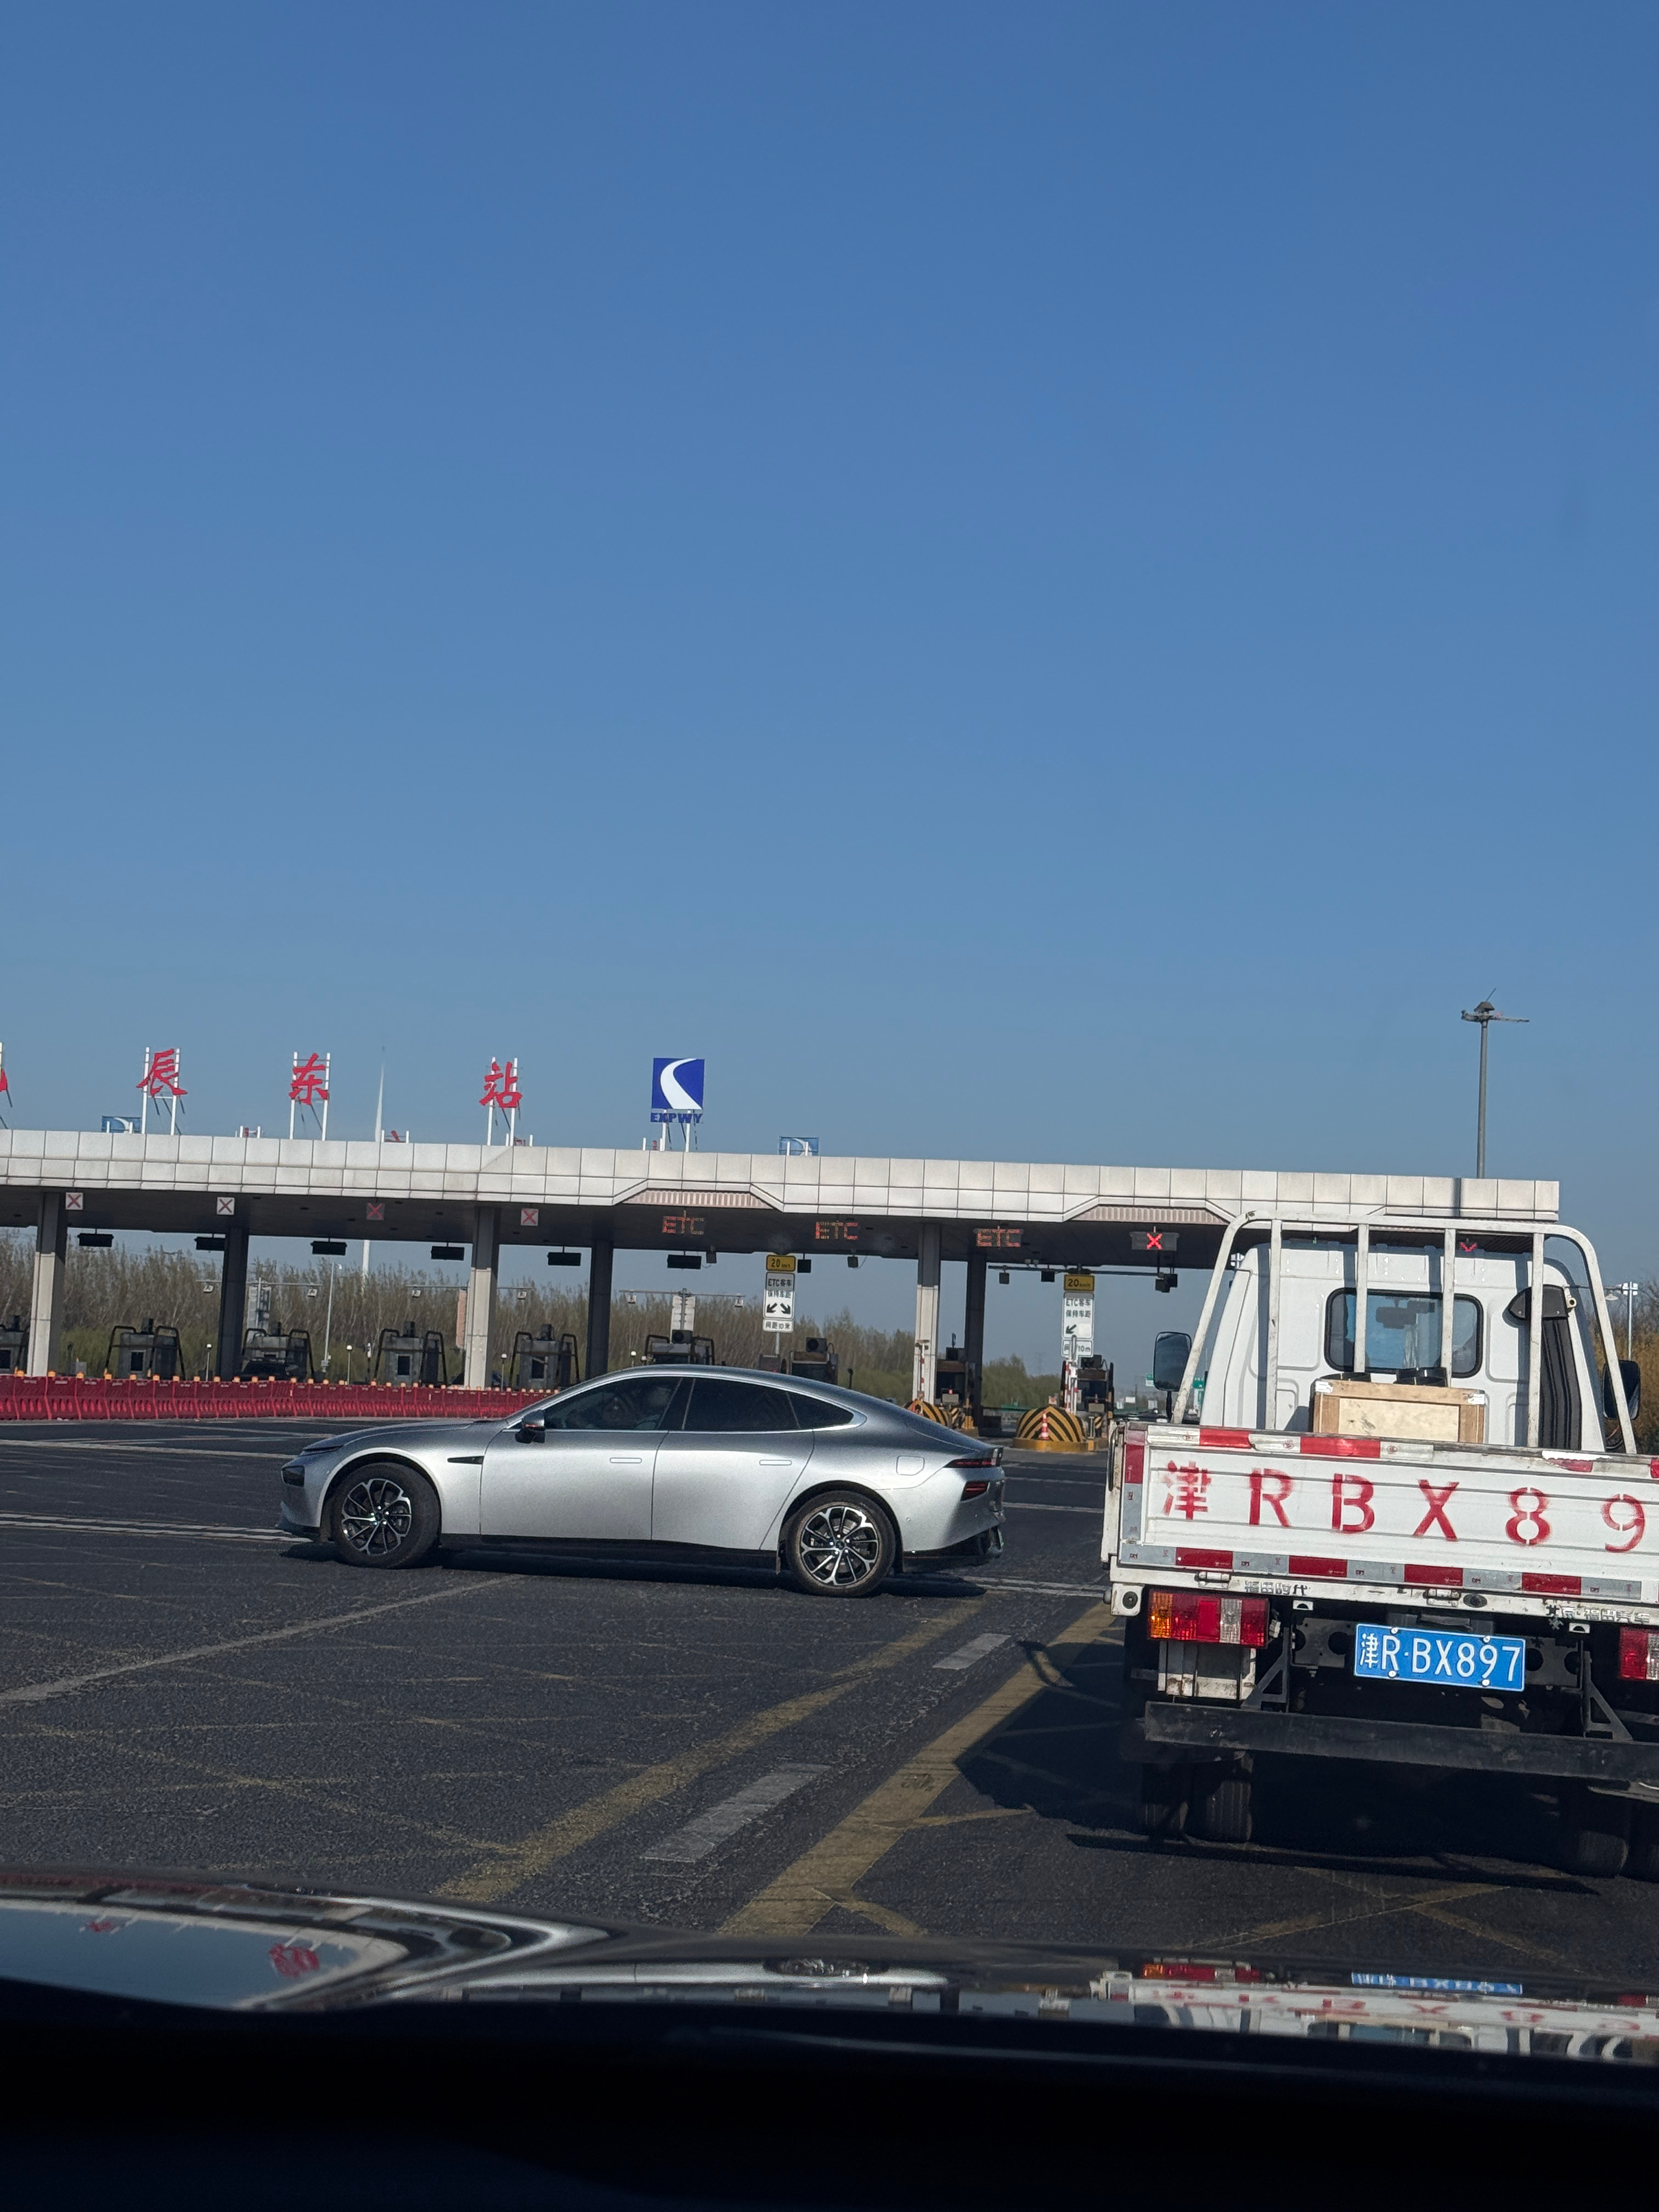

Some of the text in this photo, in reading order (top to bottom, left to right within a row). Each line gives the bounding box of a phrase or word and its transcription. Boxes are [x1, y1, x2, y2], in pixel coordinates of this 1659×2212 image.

[651, 1113, 702, 1123] EXPWY
[662, 1216, 704, 1235] ETC
[815, 1221, 858, 1240] ETC
[977, 1228, 1020, 1247] ETC
[771, 1259, 781, 1268] 20
[768, 1279, 792, 1287] ETC客车
[1068, 1278, 1079, 1287] 20
[1066, 1298, 1091, 1306] ETC客车
[1244, 1580, 1308, 1596] 福田时代
